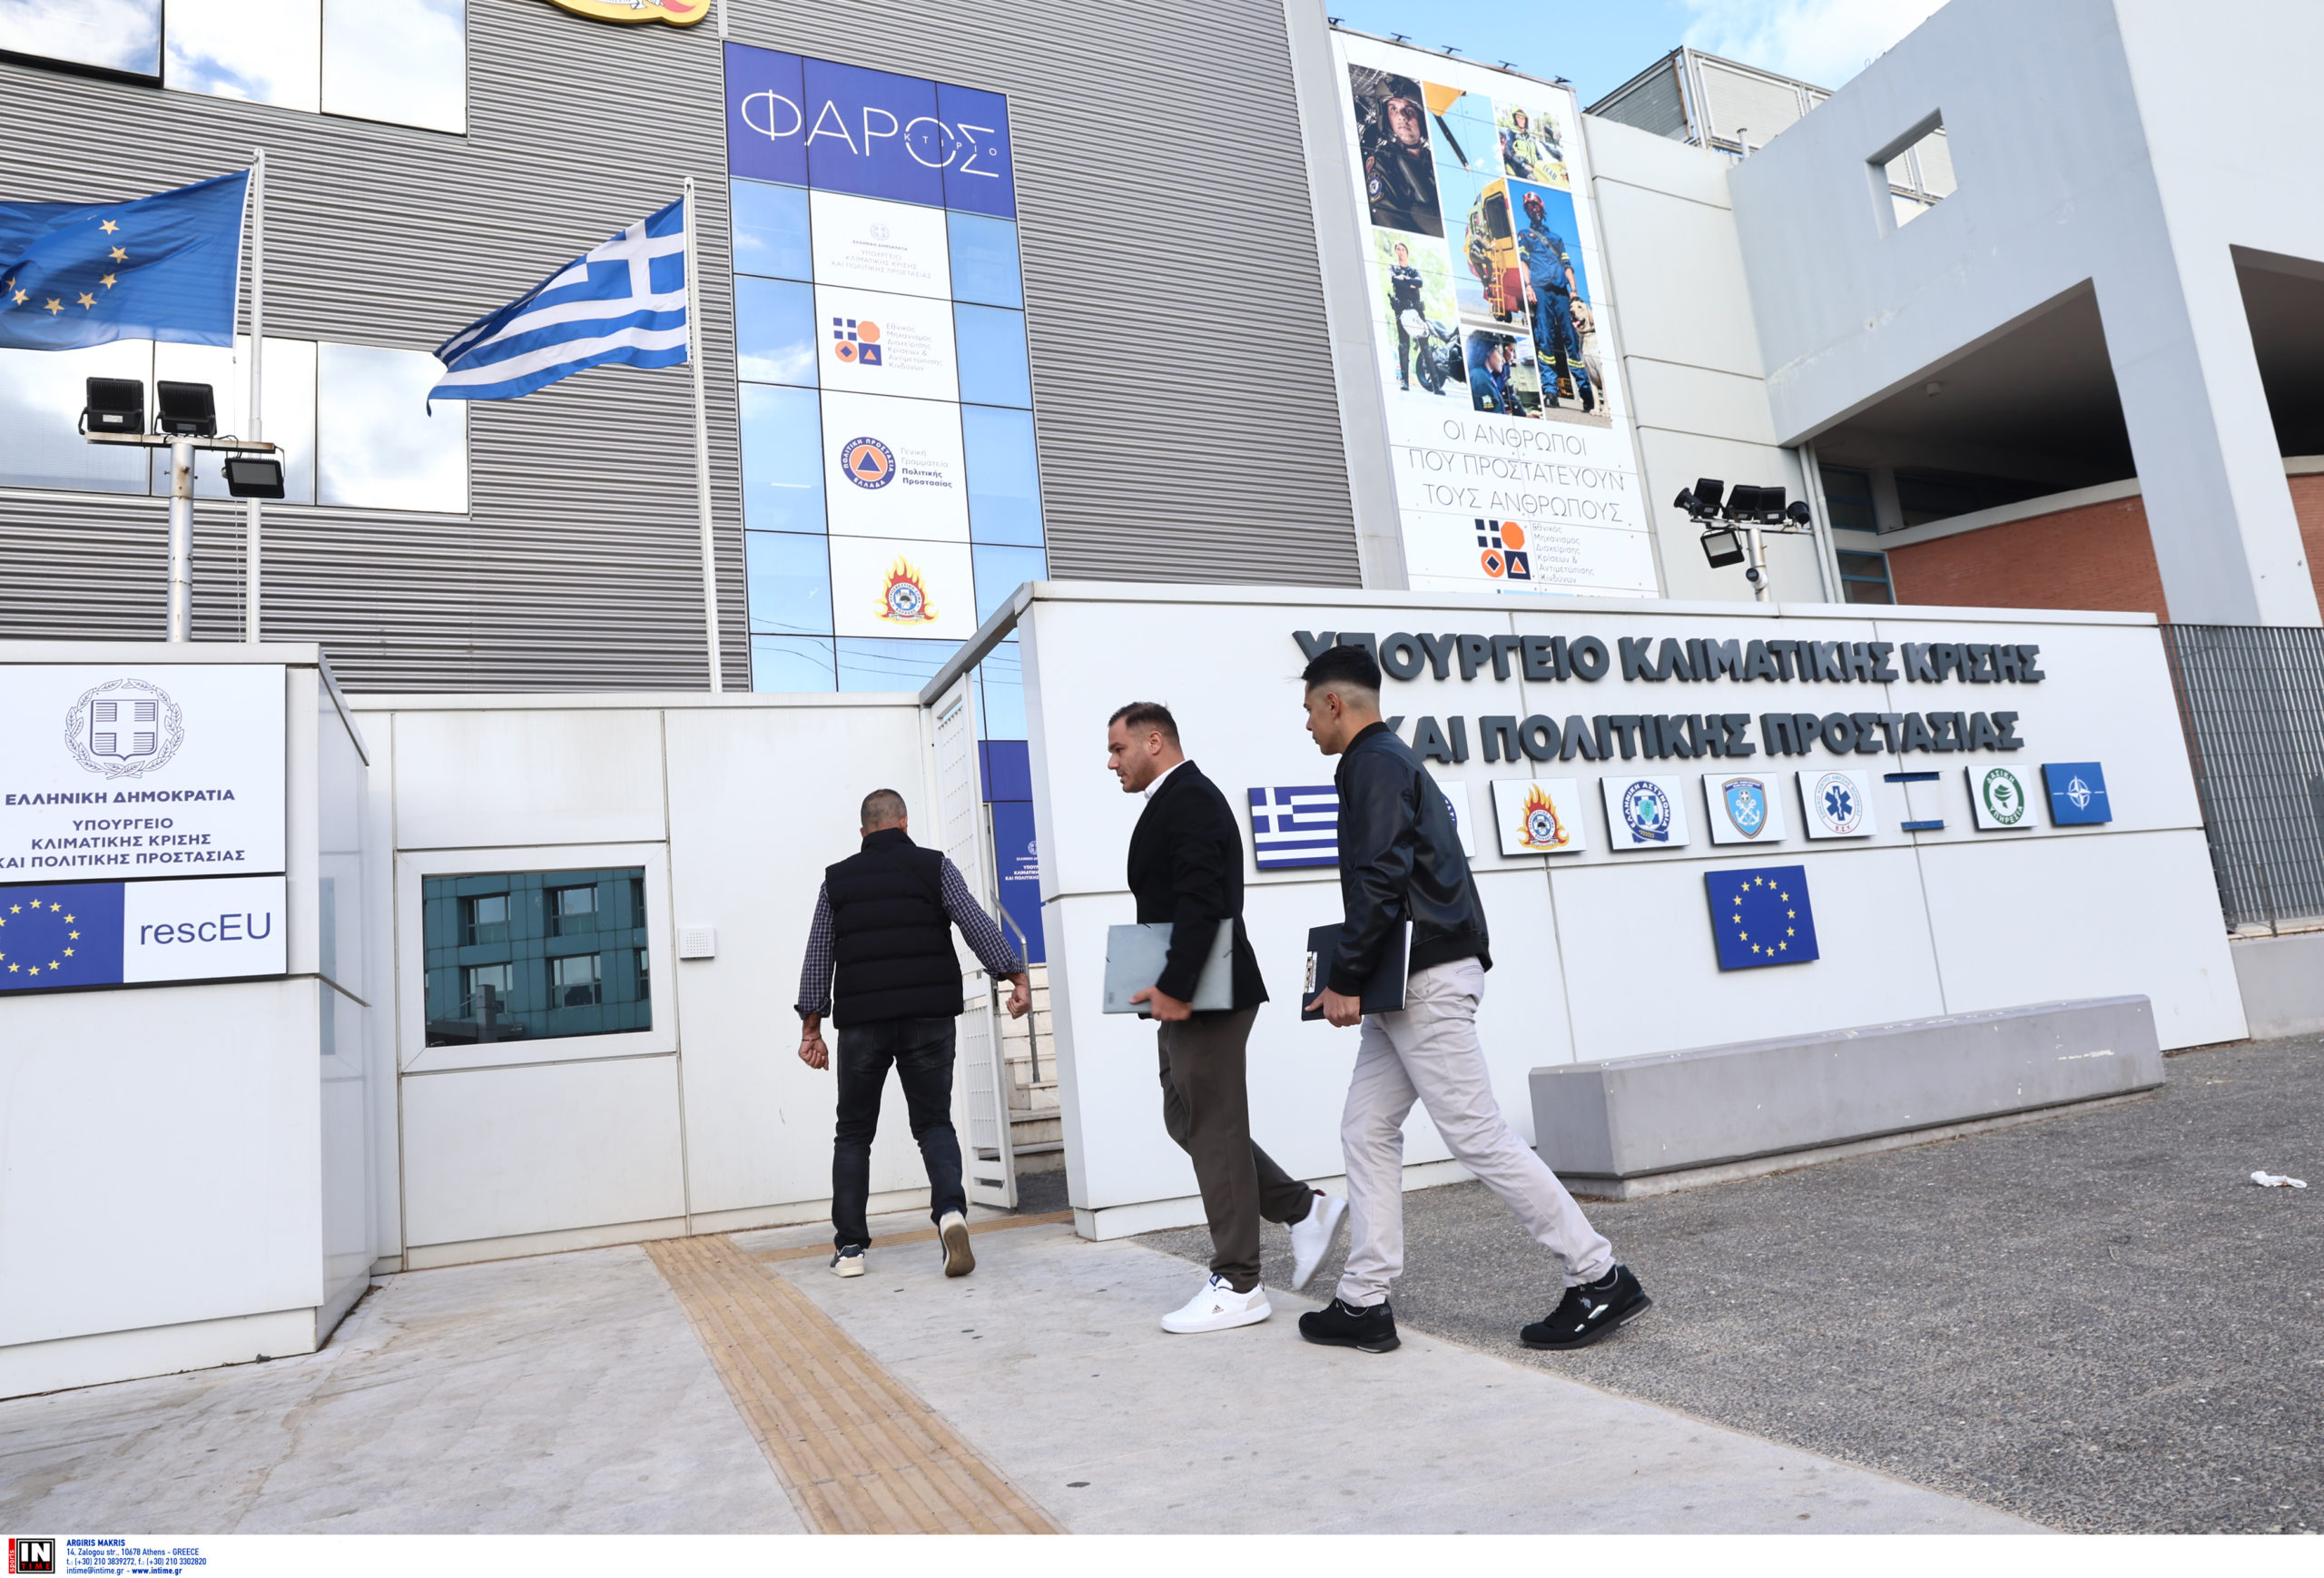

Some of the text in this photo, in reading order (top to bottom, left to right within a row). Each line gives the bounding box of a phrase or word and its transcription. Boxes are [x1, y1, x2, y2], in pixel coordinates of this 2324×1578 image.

[741, 89, 1000, 178] ΦΑΡΟΣ
[1443, 419, 1587, 456] ΟΙ ΑΝΘΡΩΠΟΙ
[842, 439, 894, 472] ΠΟΛΙΤΙΚΗ ΠΡΟΣΤΑΣΙΑ
[1409, 449, 1625, 491] ΠΟΥ ΠΡΟΣΤΑΤΕΥΟΥΝ
[853, 477, 886, 488] ΕΛΛΑΔΑ
[901, 468, 943, 478] Πολιτικής
[902, 478, 953, 488] Προστασίας
[1423, 483, 1624, 522] ΤΟΥΣ ΑΝΘΡΩΠΟΥΣ
[1618, 636, 1900, 683] ΚΛΙΜΑΤΙΚΗΣ
[1901, 641, 2046, 684] ΚΡΙΣΗΣ
[1384, 711, 2024, 764] ΑΙ ΠΟΛΙΤΙΚΗΣ ΠΡΟΣΤΑΣΙΑΣ
[5, 789, 236, 806] ΕΛΛΗΝΙΚΗ ΔΗΜΟΚΡΑΤΙΑ
[1624, 783, 1670, 828] ΕΛΛΗΝΙΚΗ ΑΣΤΥΝΟΜΙΑ
[31, 833, 212, 850] ΚΛΙΜΑΤΙΚΗΣ ΚΡΙΣΗΣ
[73, 818, 174, 832] ΥΠΟΥΡΓΕΙΟ
[31, 853, 131, 868] ΠΟΛΙΤΙΚΗΣ
[136, 850, 246, 864] ΠΡΟΣΤΑΣΙΑΣ
[140, 912, 271, 946] rescEU
